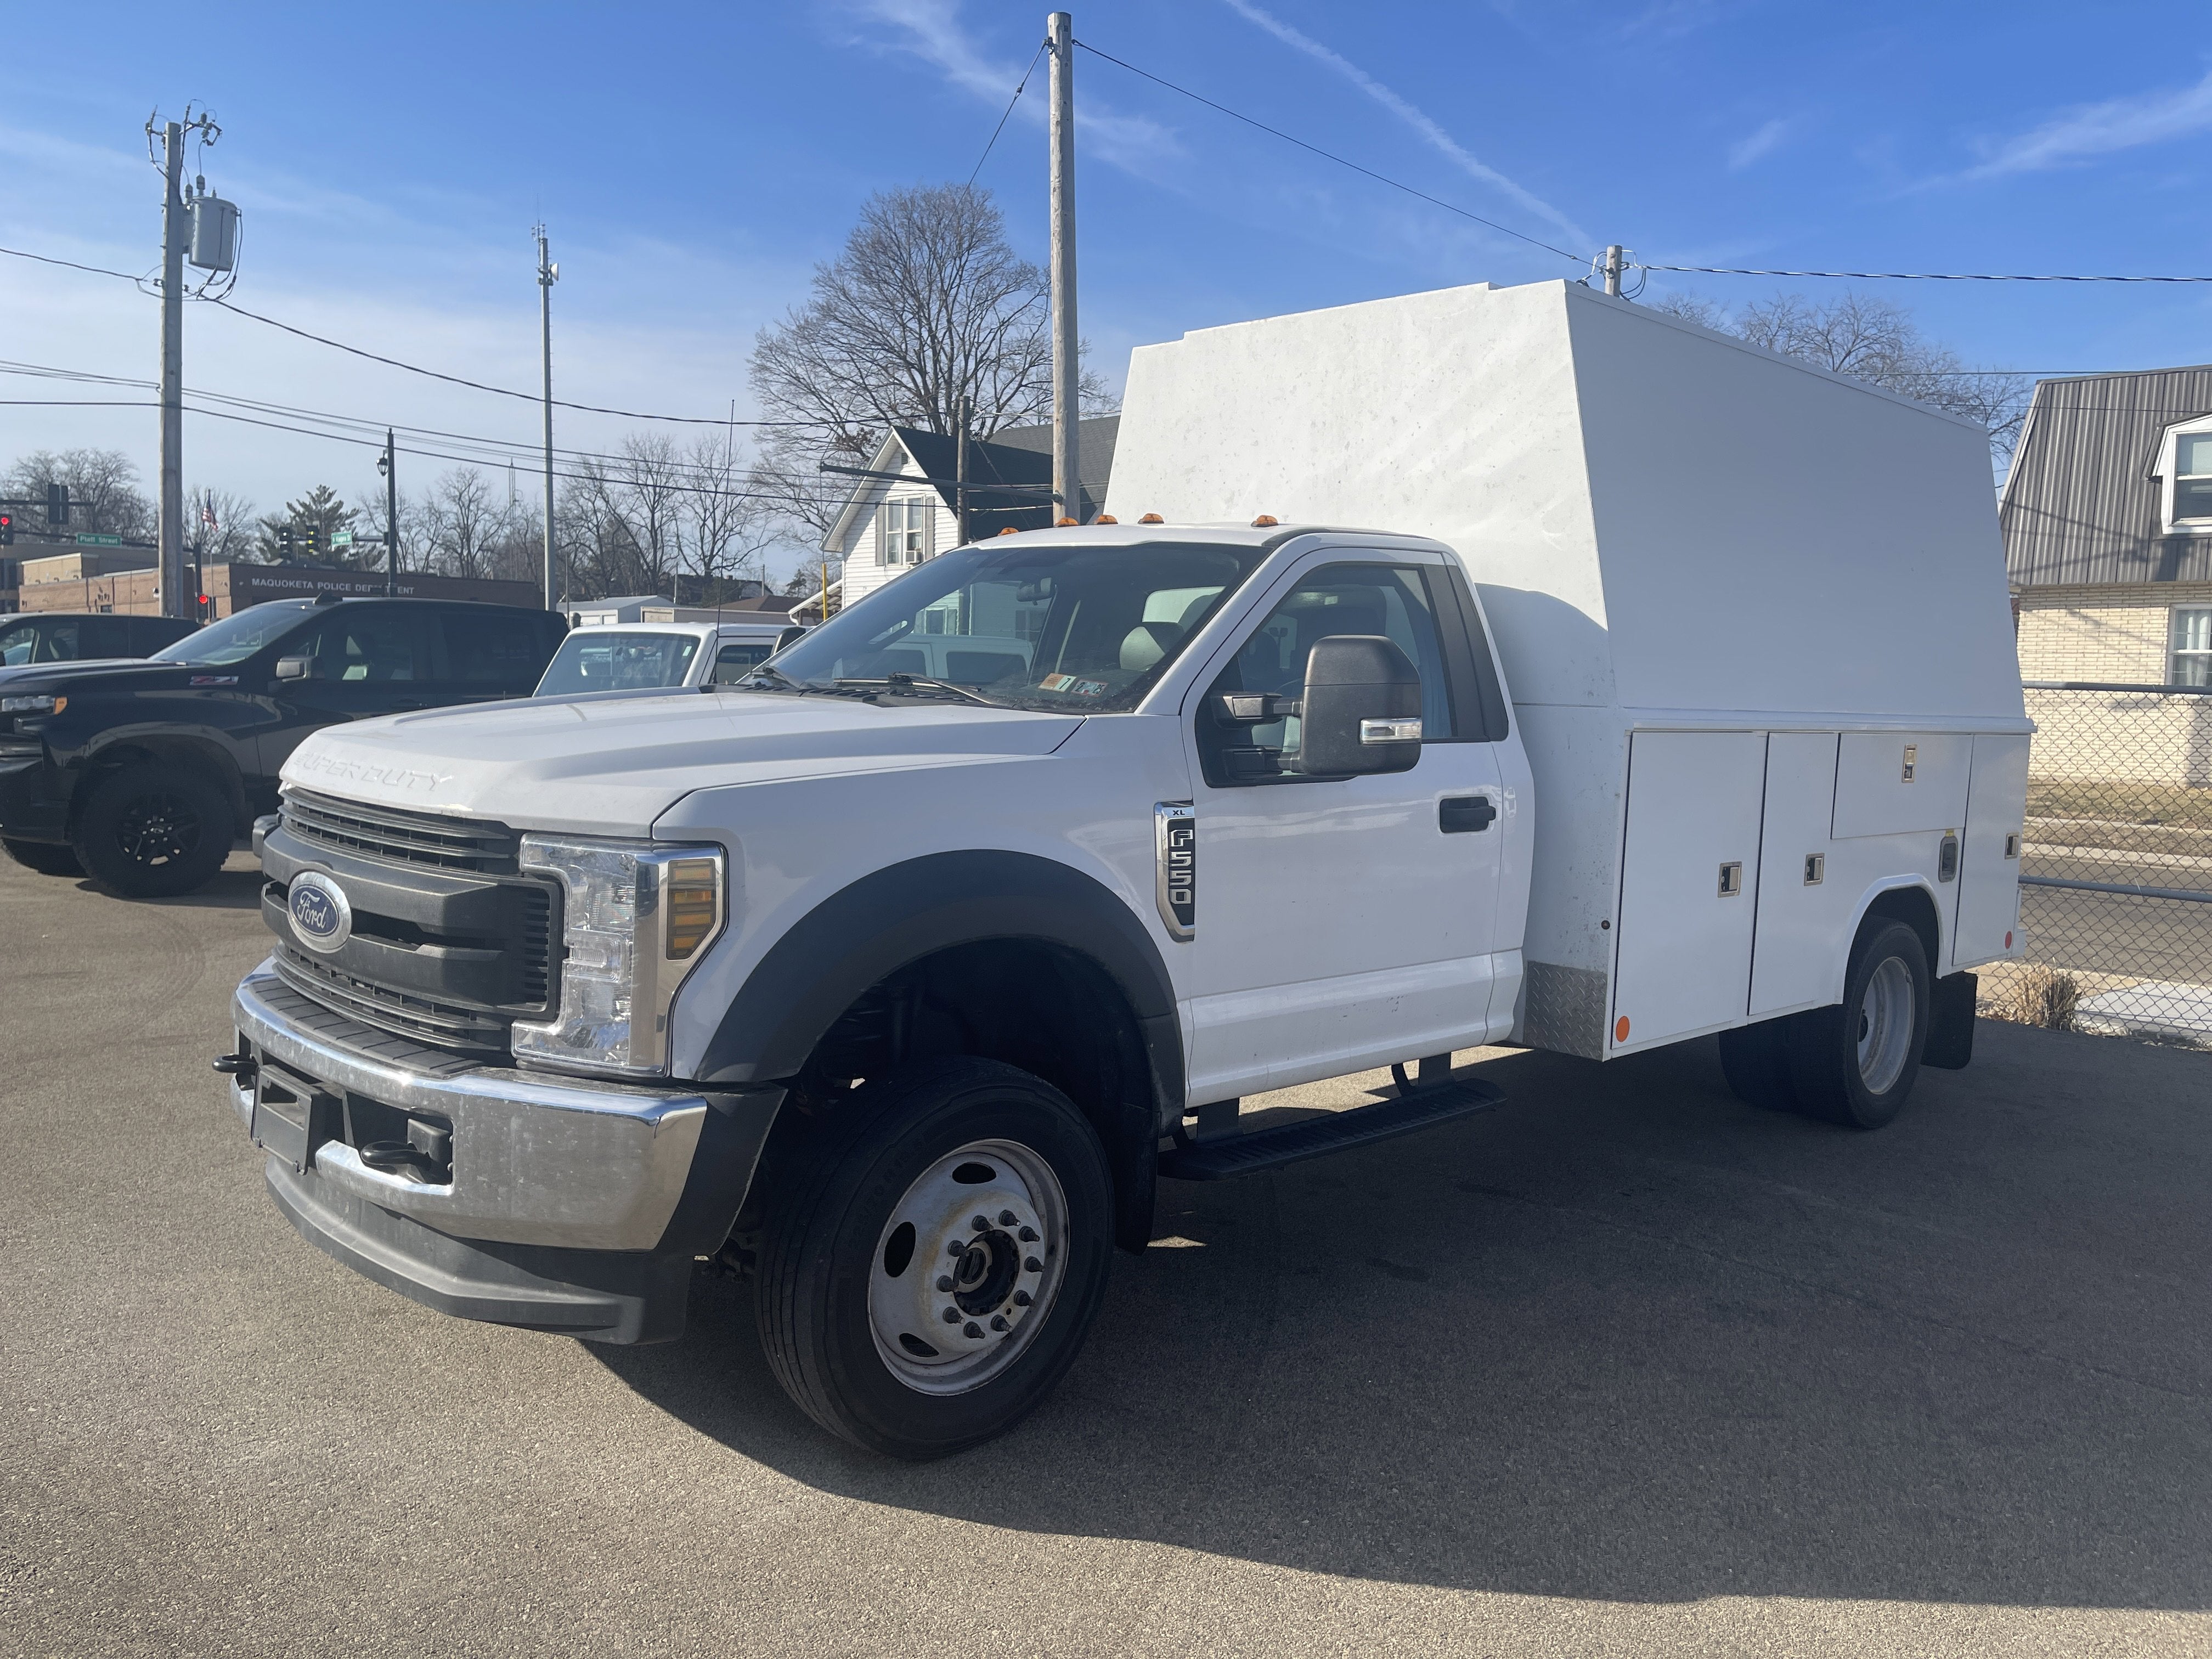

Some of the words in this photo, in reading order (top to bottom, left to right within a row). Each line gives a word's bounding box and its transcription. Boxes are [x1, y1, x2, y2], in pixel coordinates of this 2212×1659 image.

[251, 578, 314, 590] MAQUOKETA
[317, 582, 352, 592] POLICE
[355, 583, 415, 595] DEPTENT
[1059, 678, 1071, 690] 7
[294, 752, 361, 780] SUPER
[360, 765, 455, 792] DUTY
[1169, 829, 1193, 905] F550
[297, 890, 328, 929] Ford
